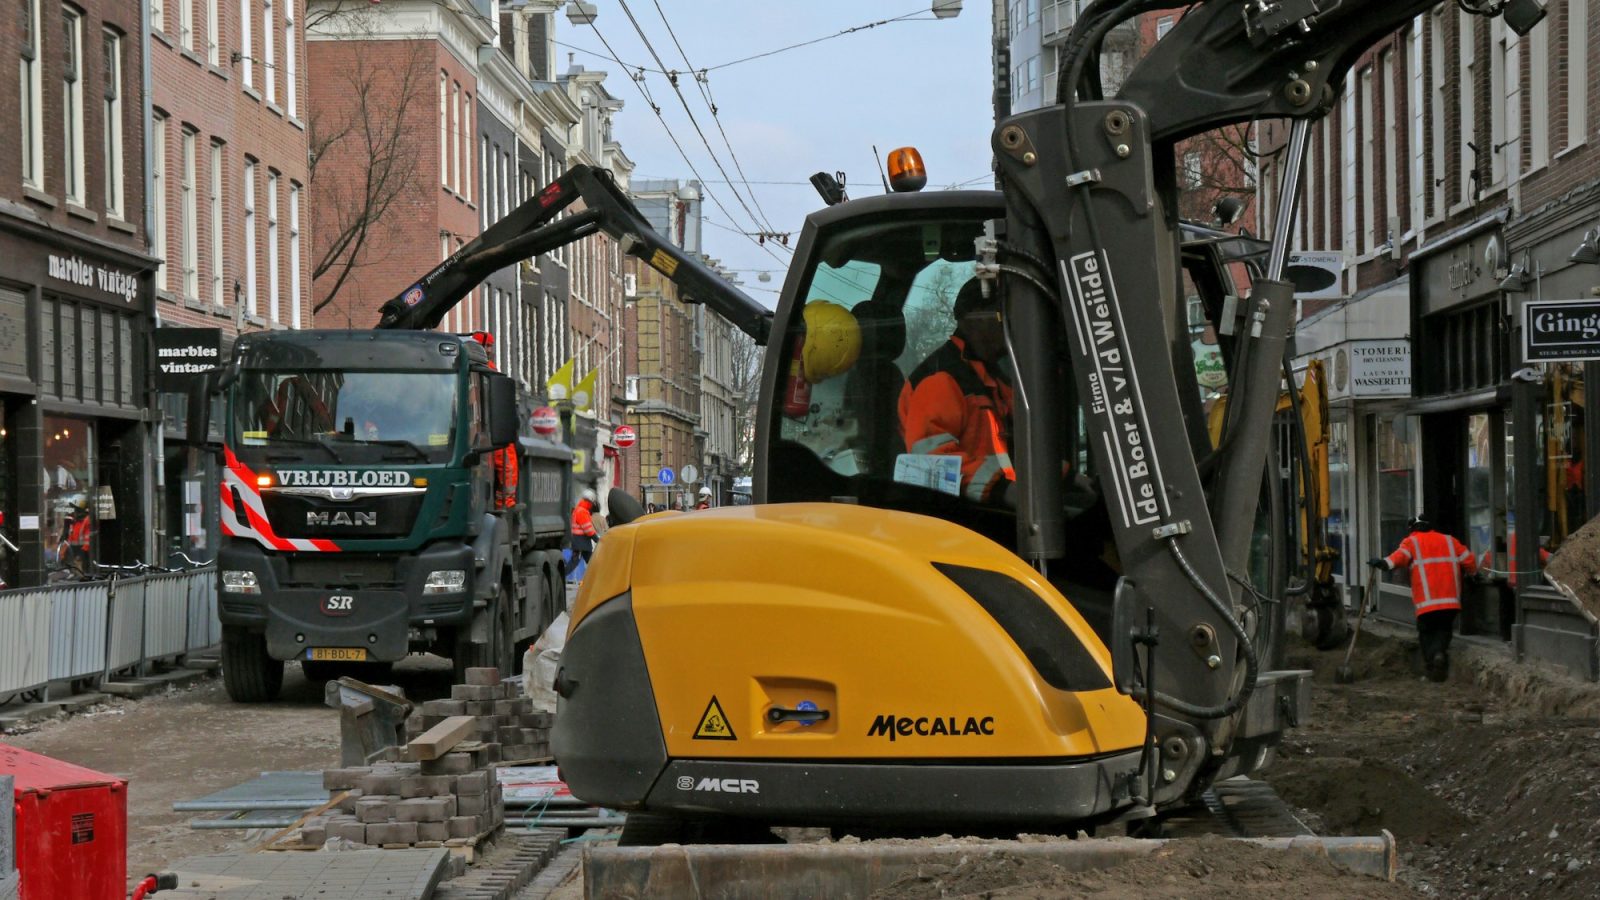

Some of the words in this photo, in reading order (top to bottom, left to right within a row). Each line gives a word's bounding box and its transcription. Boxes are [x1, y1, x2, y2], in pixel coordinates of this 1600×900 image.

[48, 254, 93, 287] marbles
[97, 264, 137, 303] vintage
[158, 345, 218, 357] marbles
[1353, 346, 1411, 356] STOMERI
[1088, 373, 1106, 414] Firma
[1114, 397, 1134, 415] &
[1124, 422, 1149, 479] Boer
[276, 470, 411, 487] VRIJBLOED
[1136, 483, 1159, 514] de
[306, 511, 377, 526] MAN
[327, 596, 353, 610] SR
[317, 649, 361, 660] 81-BDL-7
[676, 776, 695, 791] 8
[695, 779, 760, 794] MCR
